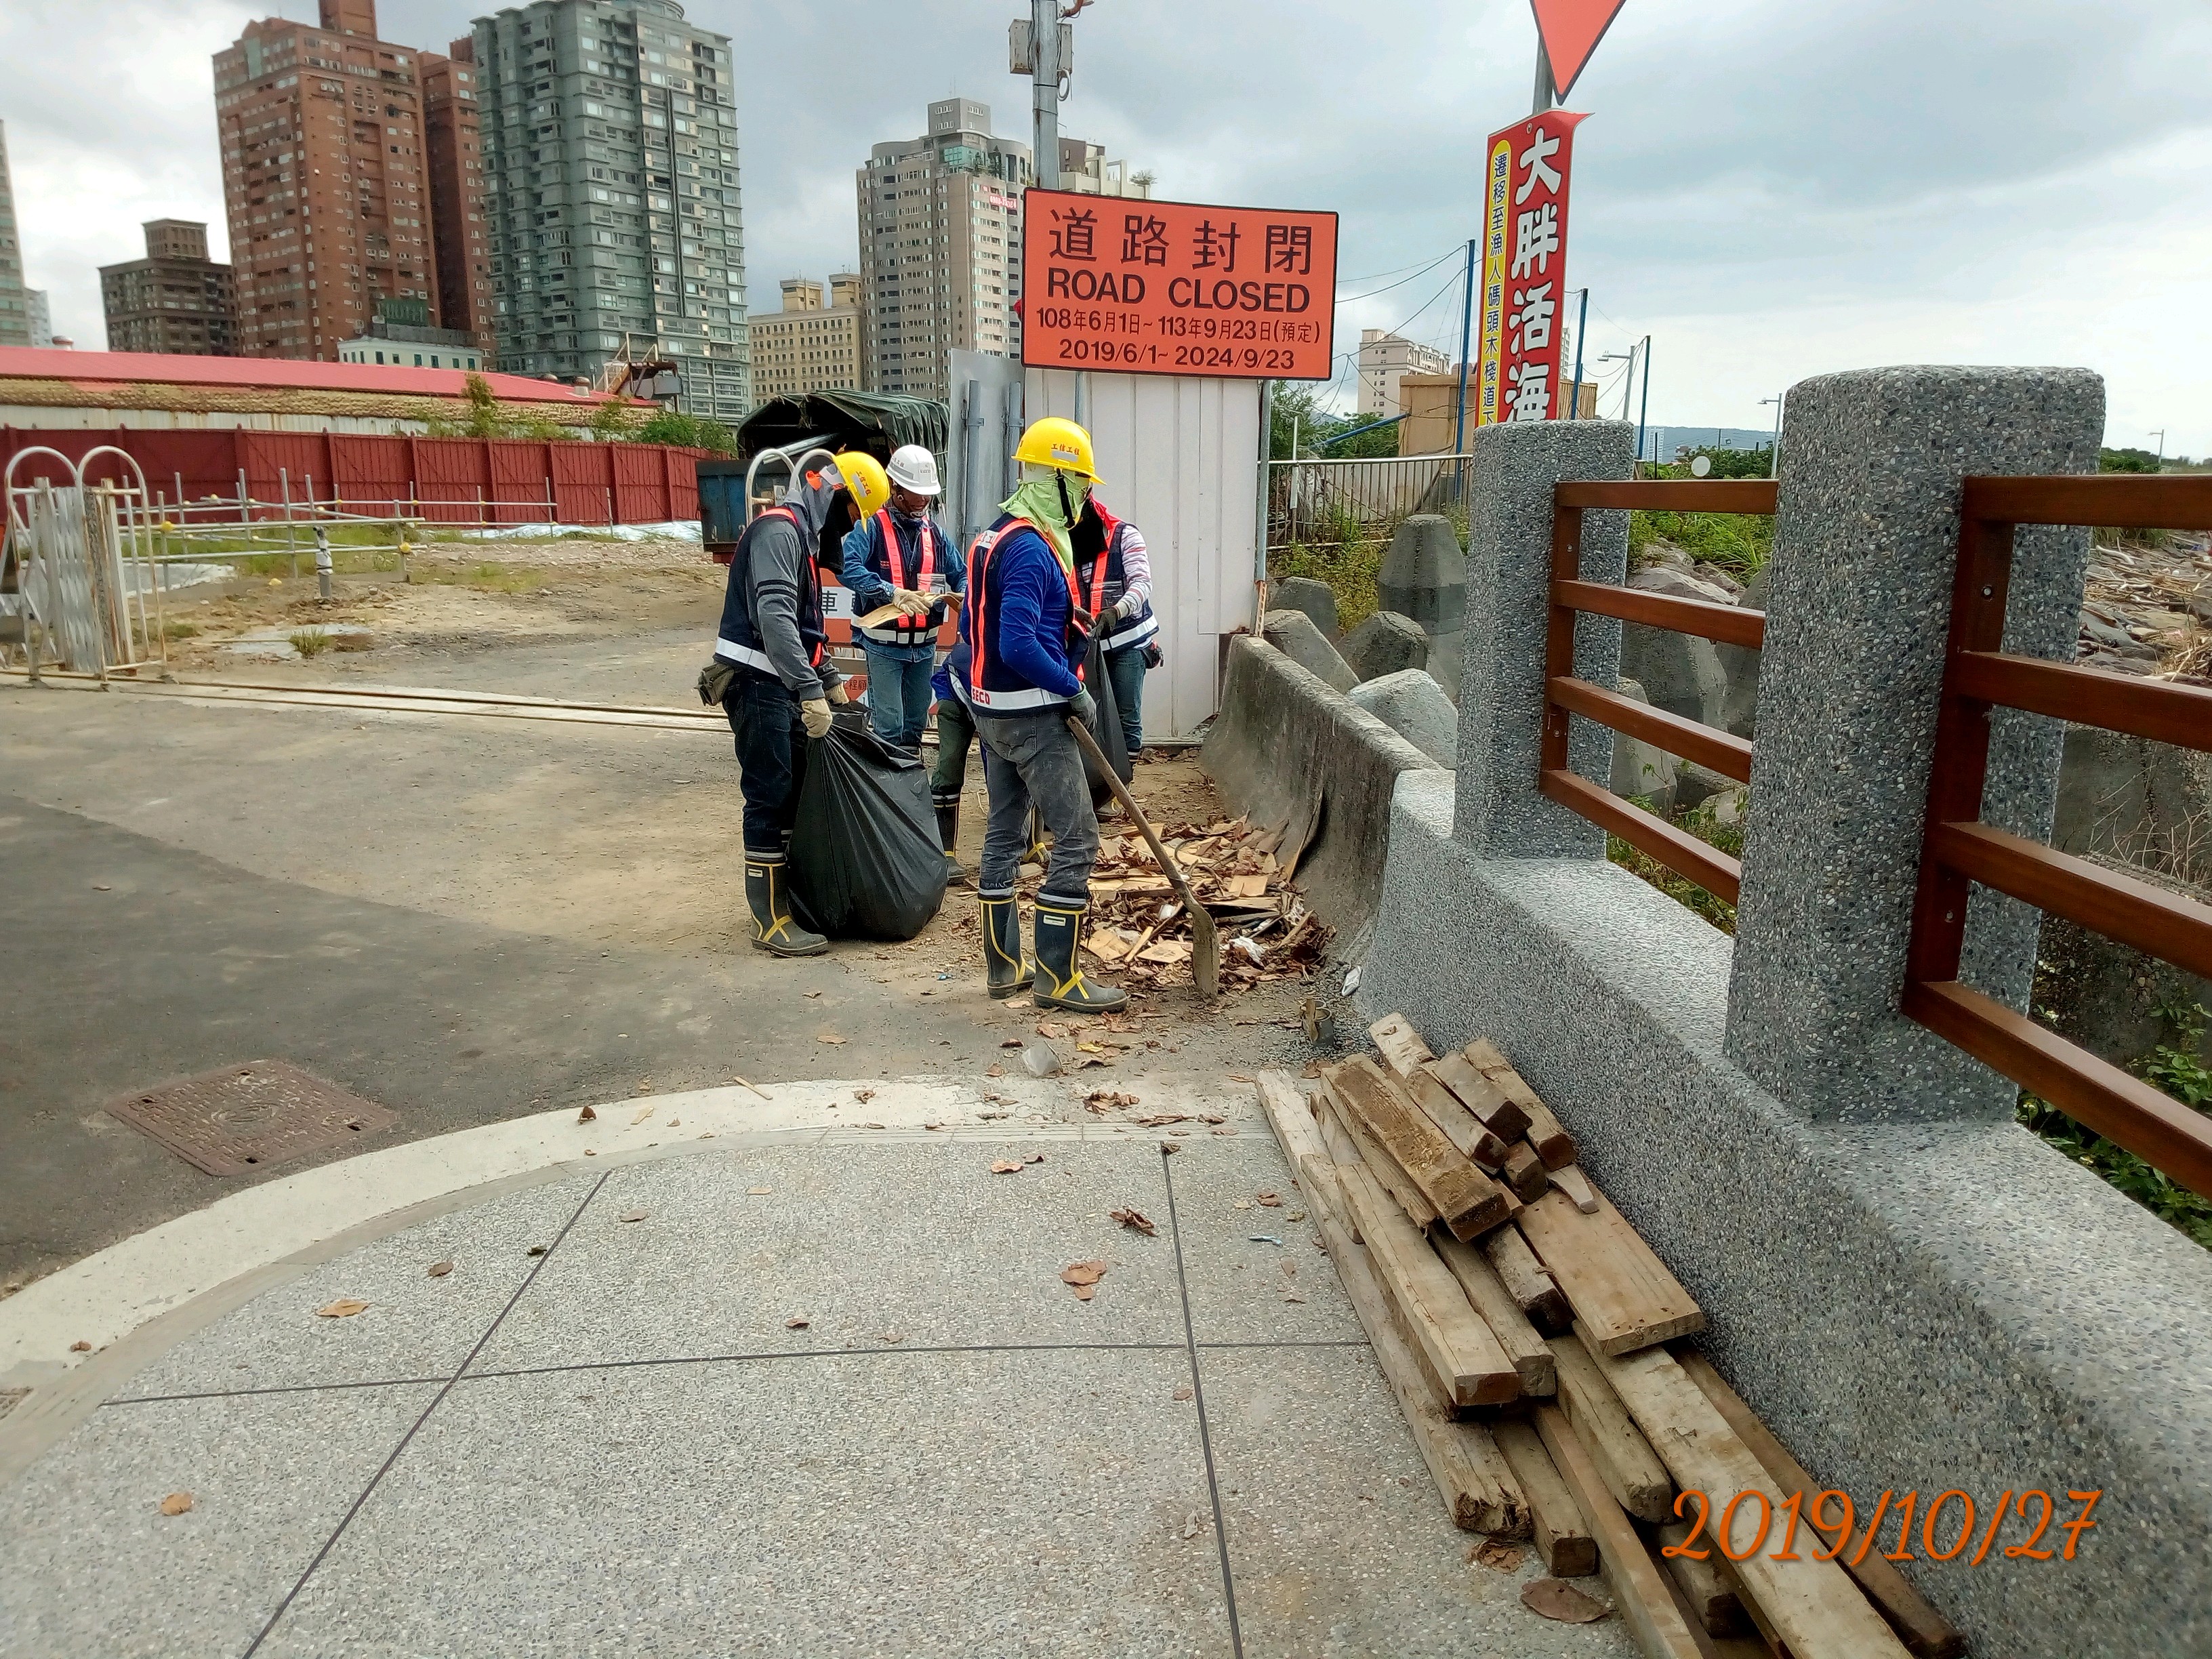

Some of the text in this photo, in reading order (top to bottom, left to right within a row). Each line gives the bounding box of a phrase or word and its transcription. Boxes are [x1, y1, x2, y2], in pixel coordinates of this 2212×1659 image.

[1049, 207, 1312, 275] 道路封閉
[1047, 267, 1310, 313] ROAD CLOSED
[1505, 127, 1561, 422] 大胖活海
[1051, 443, 1080, 456] 工信工程
